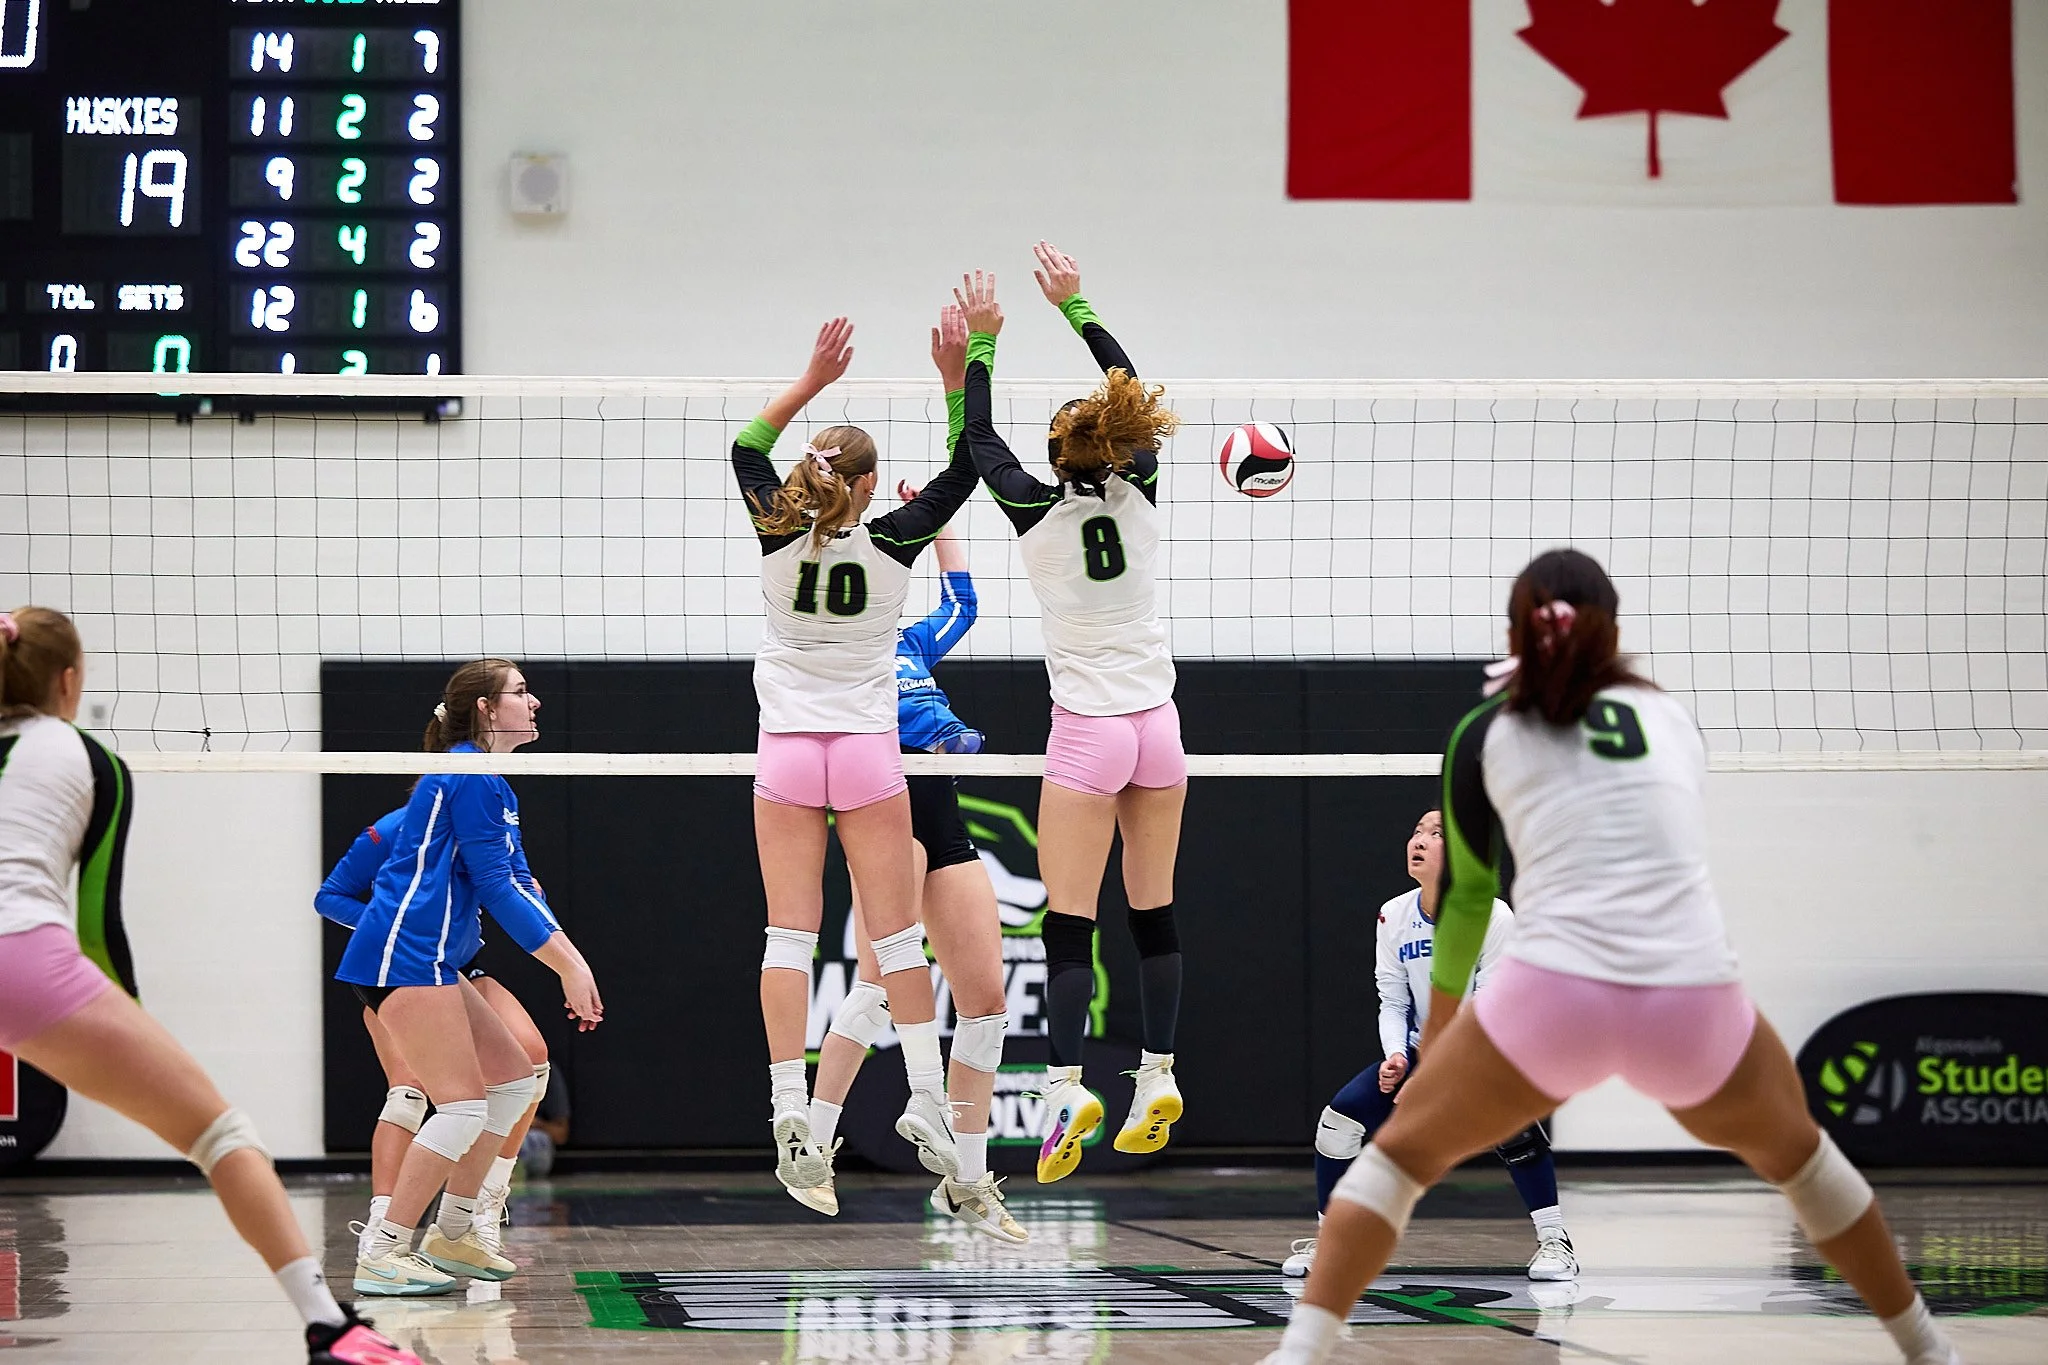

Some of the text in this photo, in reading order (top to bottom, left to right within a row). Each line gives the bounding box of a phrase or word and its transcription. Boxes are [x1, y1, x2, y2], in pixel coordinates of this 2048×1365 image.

[250, 30, 440, 73] 14 1 7
[66, 96, 179, 135] HUSKIES
[250, 94, 440, 140] 11 2 2
[120, 148, 188, 227] 19
[265, 157, 441, 204] 9 2 2
[235, 221, 441, 268] 22 4 2
[46, 284, 184, 310] TOL SETS
[250, 286, 295, 331] 12
[352, 289, 368, 328] 1
[50, 334, 191, 396] 0 0
[1080, 514, 1127, 583] 8
[792, 560, 869, 618] 10
[1581, 697, 1650, 762] 9
[1918, 1055, 2048, 1094] Stude
